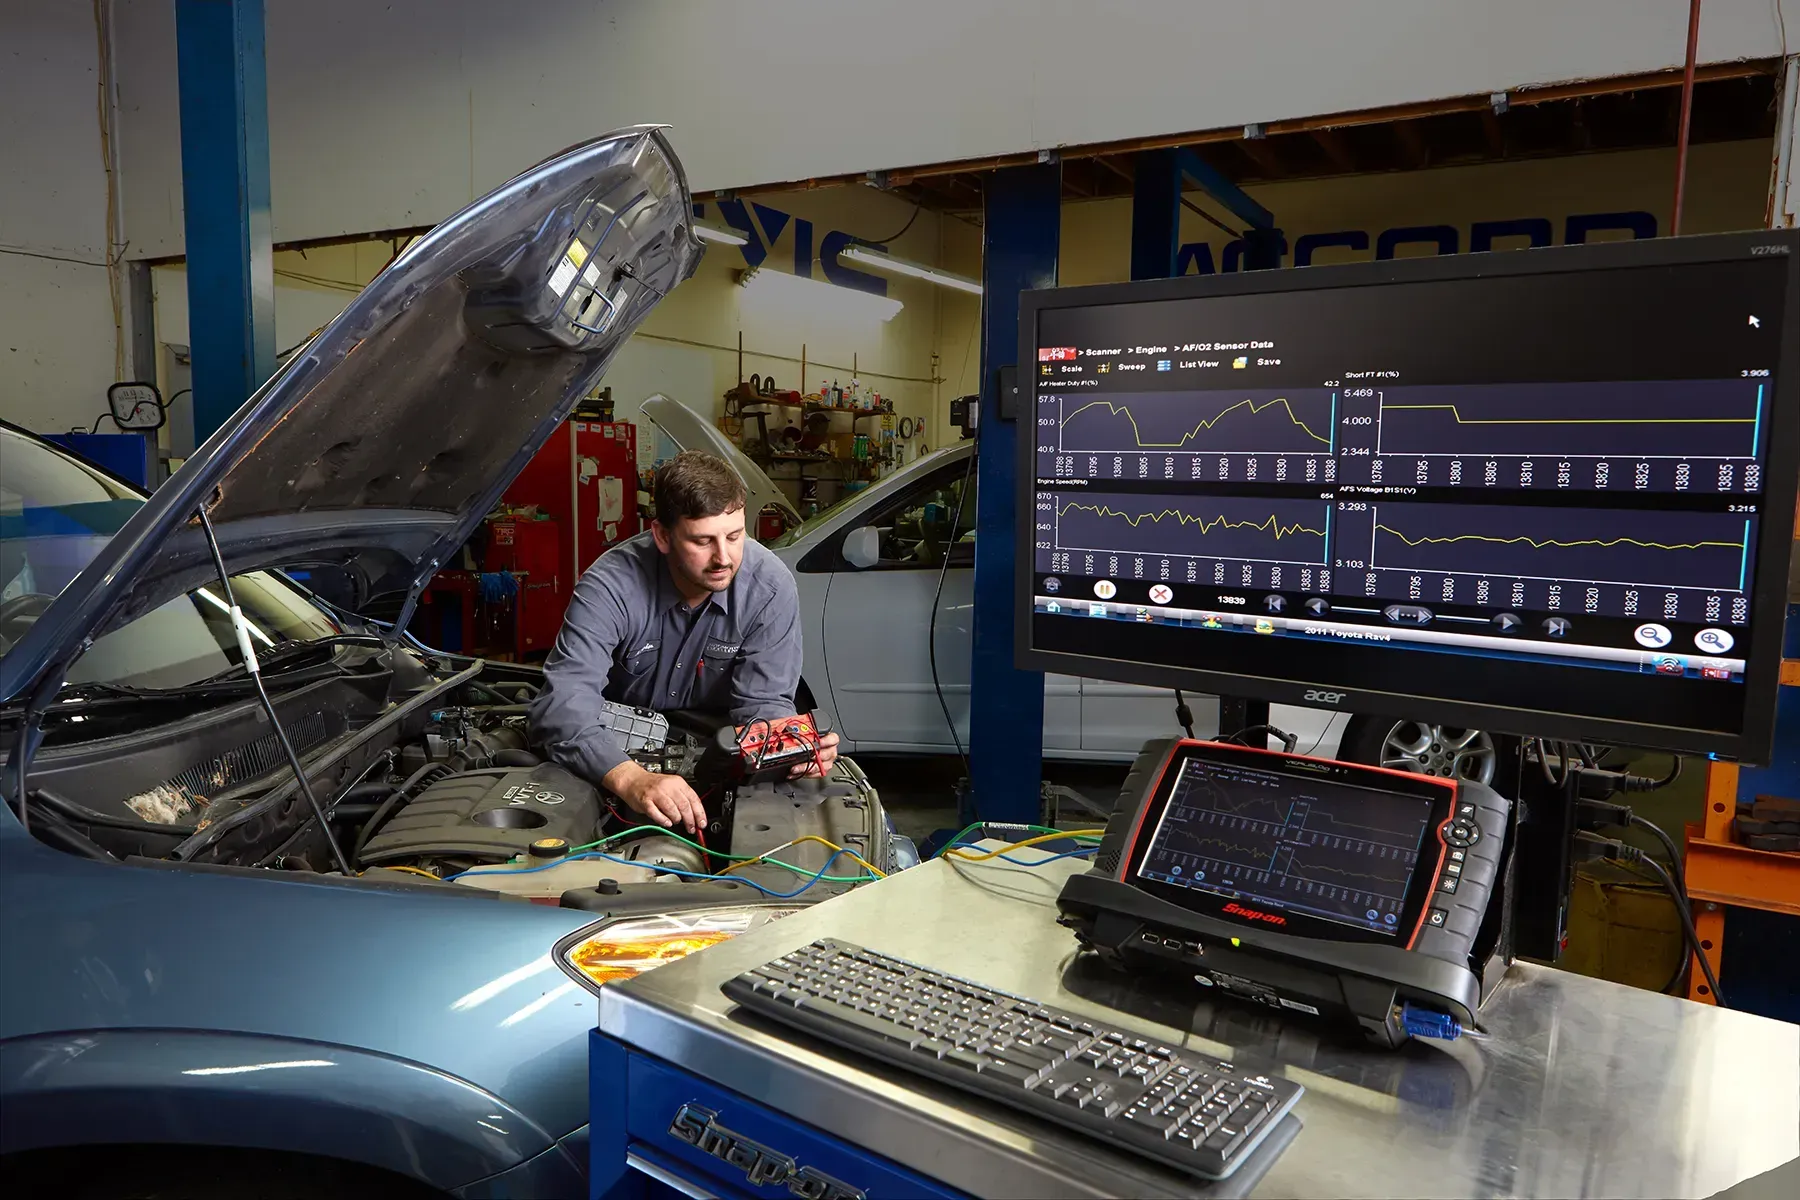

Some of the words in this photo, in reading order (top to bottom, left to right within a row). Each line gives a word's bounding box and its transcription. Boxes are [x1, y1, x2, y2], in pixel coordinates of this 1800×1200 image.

[693, 200, 888, 297] VIC
[1136, 346, 1167, 355] Engine
[1182, 343, 1211, 351] AF/O2
[1344, 389, 1373, 397] 5.469
[1343, 417, 1371, 425] 4.000
[1056, 456, 1064, 476] 13788
[1089, 457, 1097, 476] 13795
[1114, 457, 1122, 477] 13800
[1139, 457, 1148, 478] 13805
[1165, 458, 1174, 478] 13810
[1192, 458, 1201, 479] 13815
[1219, 458, 1228, 480] 13820
[1247, 459, 1256, 480] 13825
[1277, 459, 1286, 481] 13830
[1306, 459, 1316, 481] 13835
[1325, 460, 1335, 482] 13838
[1372, 460, 1383, 483] 13788
[1417, 461, 1428, 484] 13795
[1450, 461, 1461, 485] 13800
[1485, 462, 1497, 486] 13805
[1521, 462, 1533, 487] 13810
[1558, 462, 1570, 487] 13815
[1596, 463, 1608, 488] 13820
[1635, 463, 1648, 489] 13825
[1676, 464, 1689, 490] 13830
[1718, 465, 1731, 491] 13835
[1744, 465, 1760, 492] 13838
[1339, 502, 1366, 511] 3.293
[1336, 560, 1363, 568] 3.103
[1218, 596, 1245, 604] 13839
[1304, 626, 1328, 635] 2011
[1330, 628, 1362, 640] Toyota
[1364, 632, 1392, 642] Rav4
[1304, 689, 1346, 704] acer
[1222, 902, 1287, 926] Snap-on
